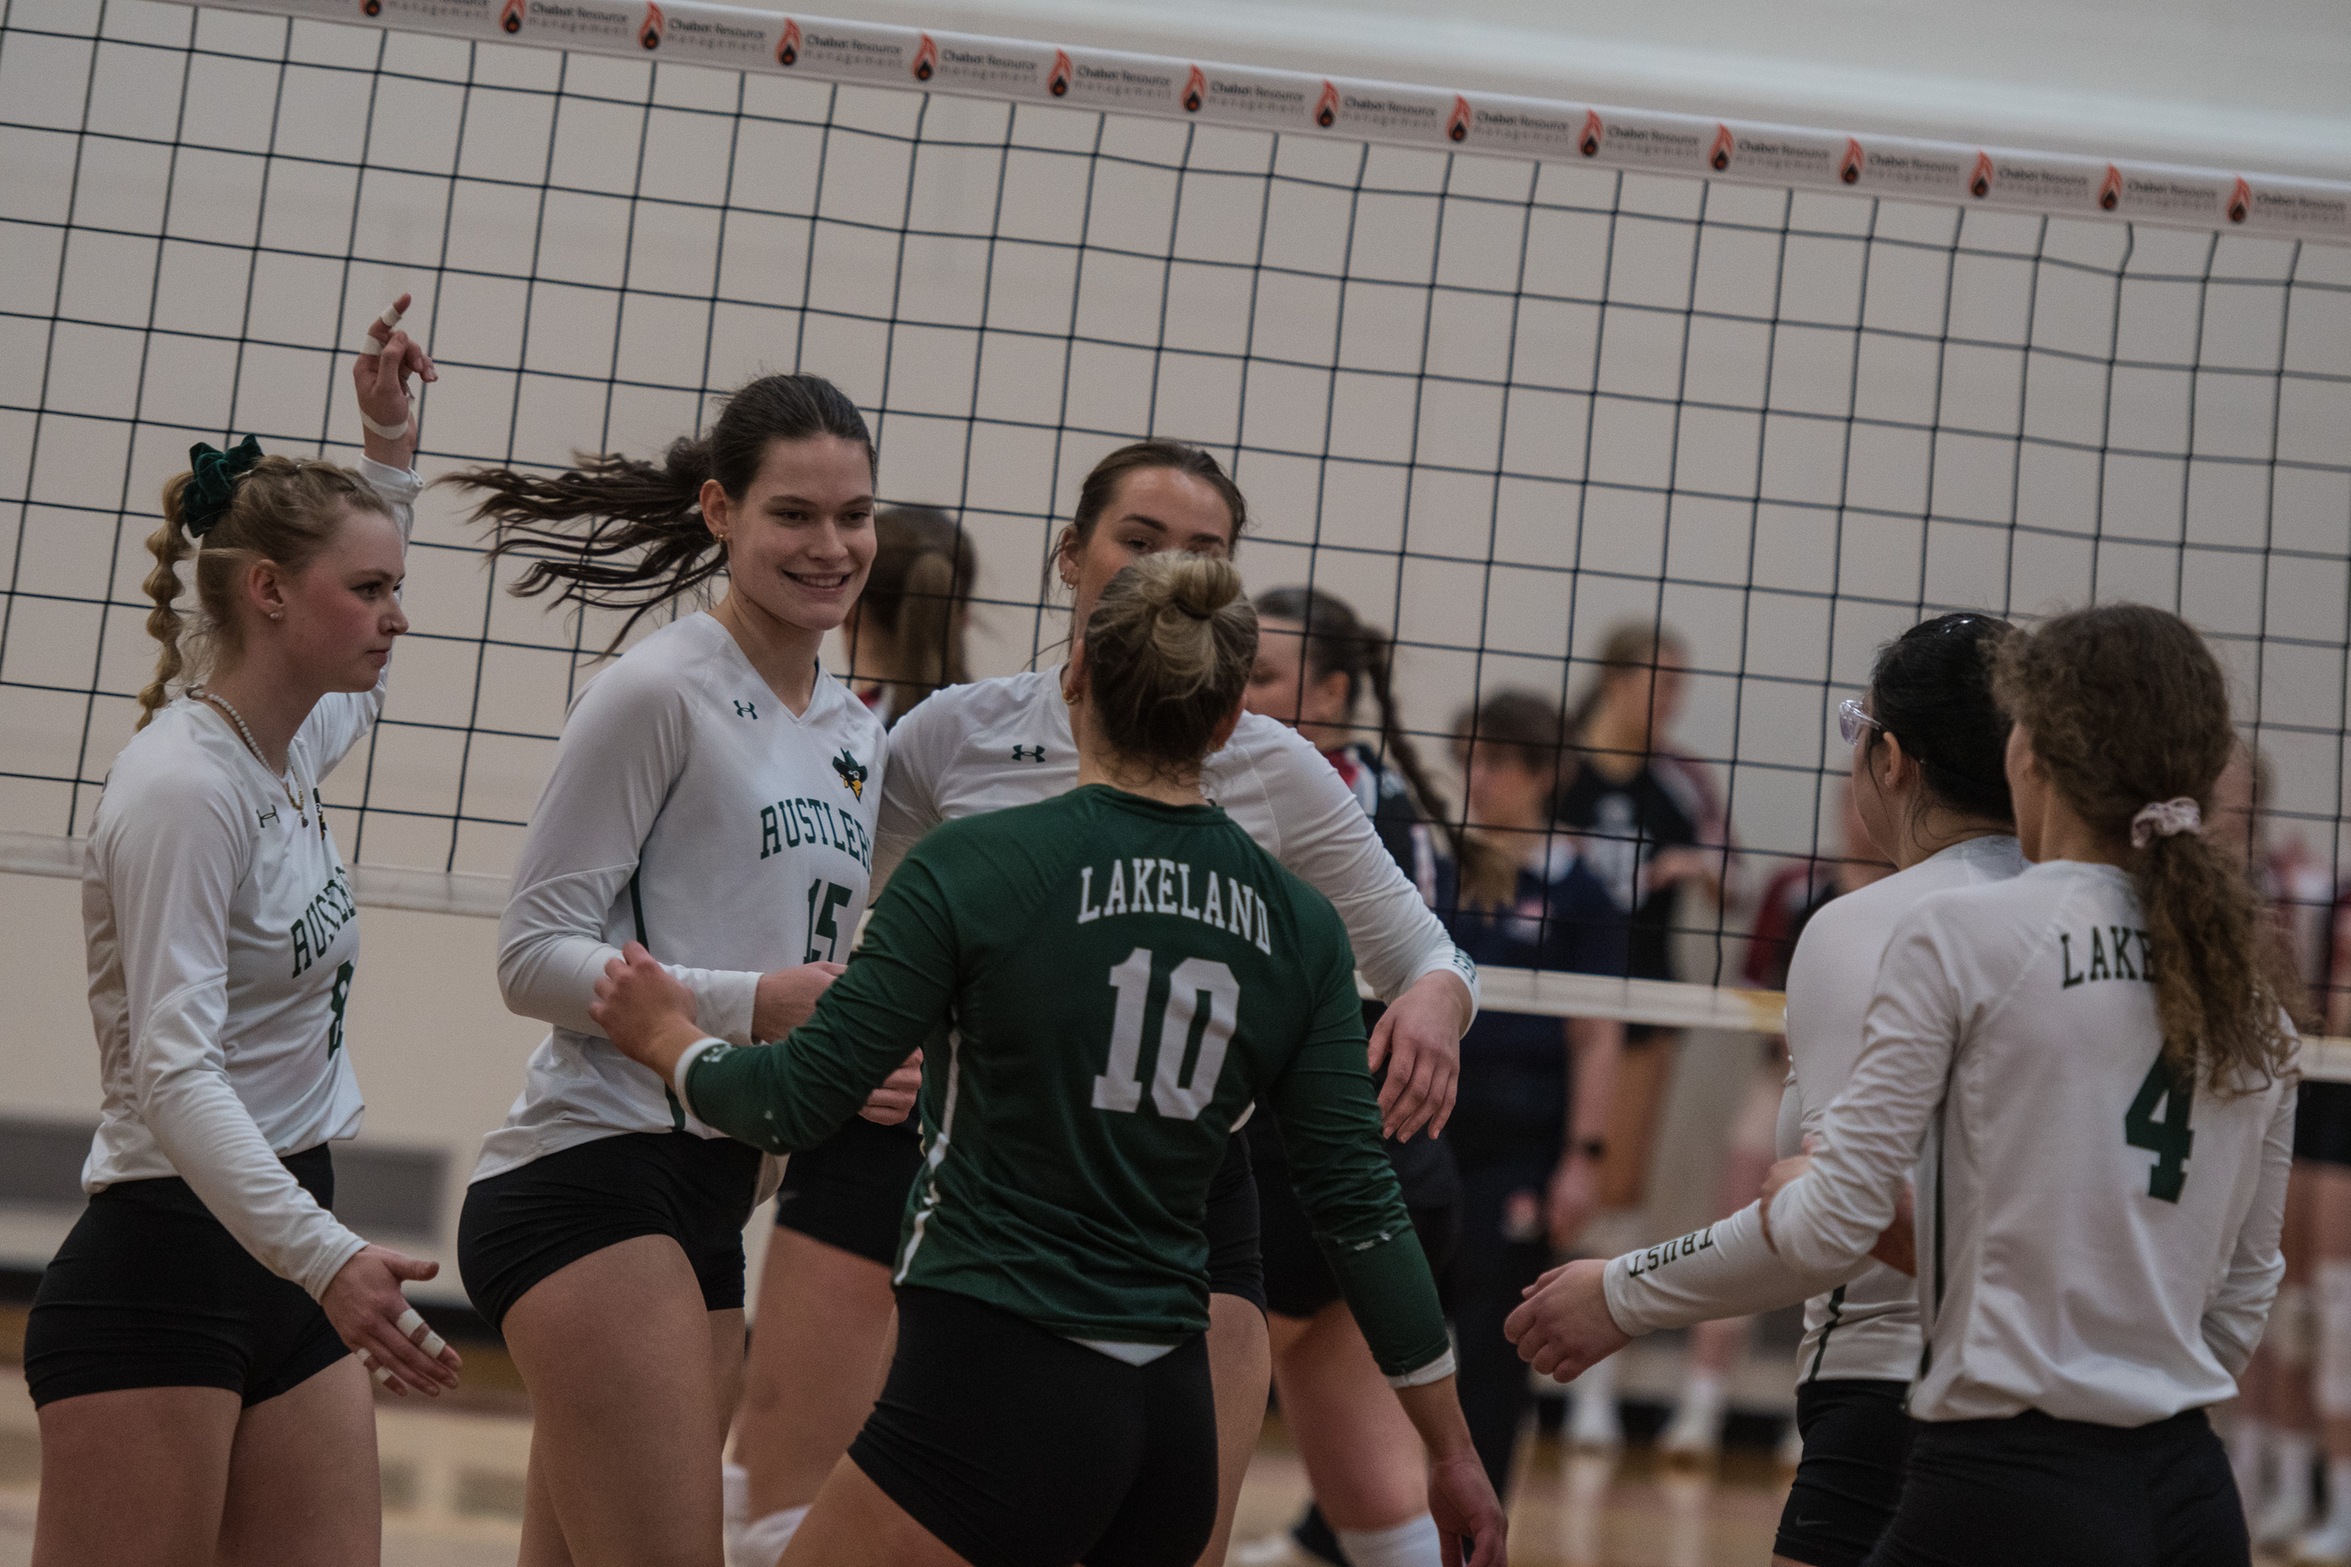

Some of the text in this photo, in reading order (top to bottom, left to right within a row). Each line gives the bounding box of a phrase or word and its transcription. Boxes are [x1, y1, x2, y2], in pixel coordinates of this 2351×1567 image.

[577, 7, 627, 23] Resource
[714, 23, 764, 38] Resource
[851, 39, 901, 54] Resource
[987, 54, 1036, 69] Resource
[1121, 70, 1170, 86] Resource
[803, 878, 853, 965] 15
[1078, 858, 1271, 956] LAKELAND
[1091, 947, 1240, 1121] 10
[2125, 1040, 2195, 1204] 4
[1629, 1229, 1713, 1278] TRUST
